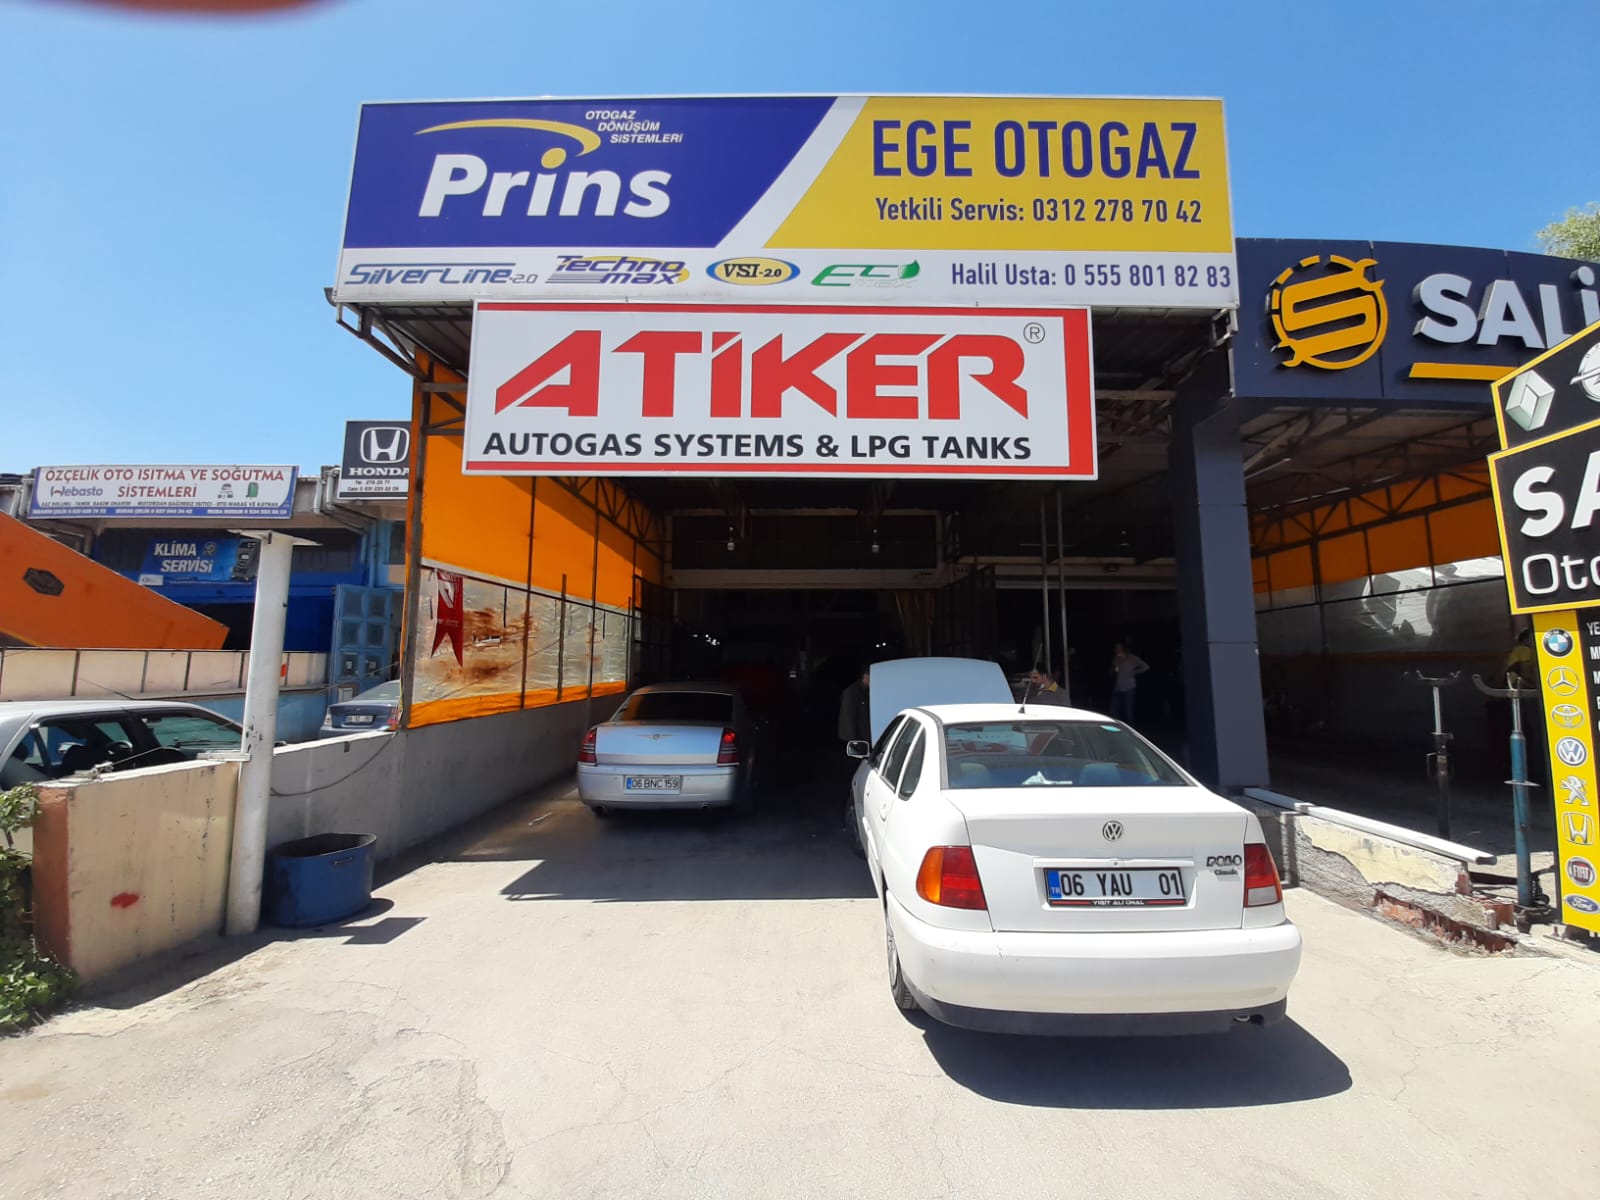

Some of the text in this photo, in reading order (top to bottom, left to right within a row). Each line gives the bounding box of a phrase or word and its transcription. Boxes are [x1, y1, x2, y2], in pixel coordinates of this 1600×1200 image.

[585, 110, 636, 120] OTOGAZ
[873, 119, 1200, 179] EGE OTOGAZ
[418, 147, 672, 218] Prins
[875, 197, 1202, 223] Yetkili Servis: 0312 278 70 42
[556, 255, 685, 272] Techno
[600, 273, 682, 284] max
[952, 262, 1231, 288] Halil Usta: 0 555 801 82 83
[482, 432, 1031, 460] AUTOGAS SYSTEMS & LPG TANKS
[103, 469, 134, 481] OTO
[138, 469, 186, 481] ISITMA
[190, 469, 208, 481] VE
[211, 466, 284, 481] SOĞUTMA
[154, 540, 197, 556] KLİMA
[643, 778, 663, 788] BNC
[1060, 873, 1085, 896] 06
[1096, 872, 1133, 896] YAU
[1158, 872, 1181, 896] 01
